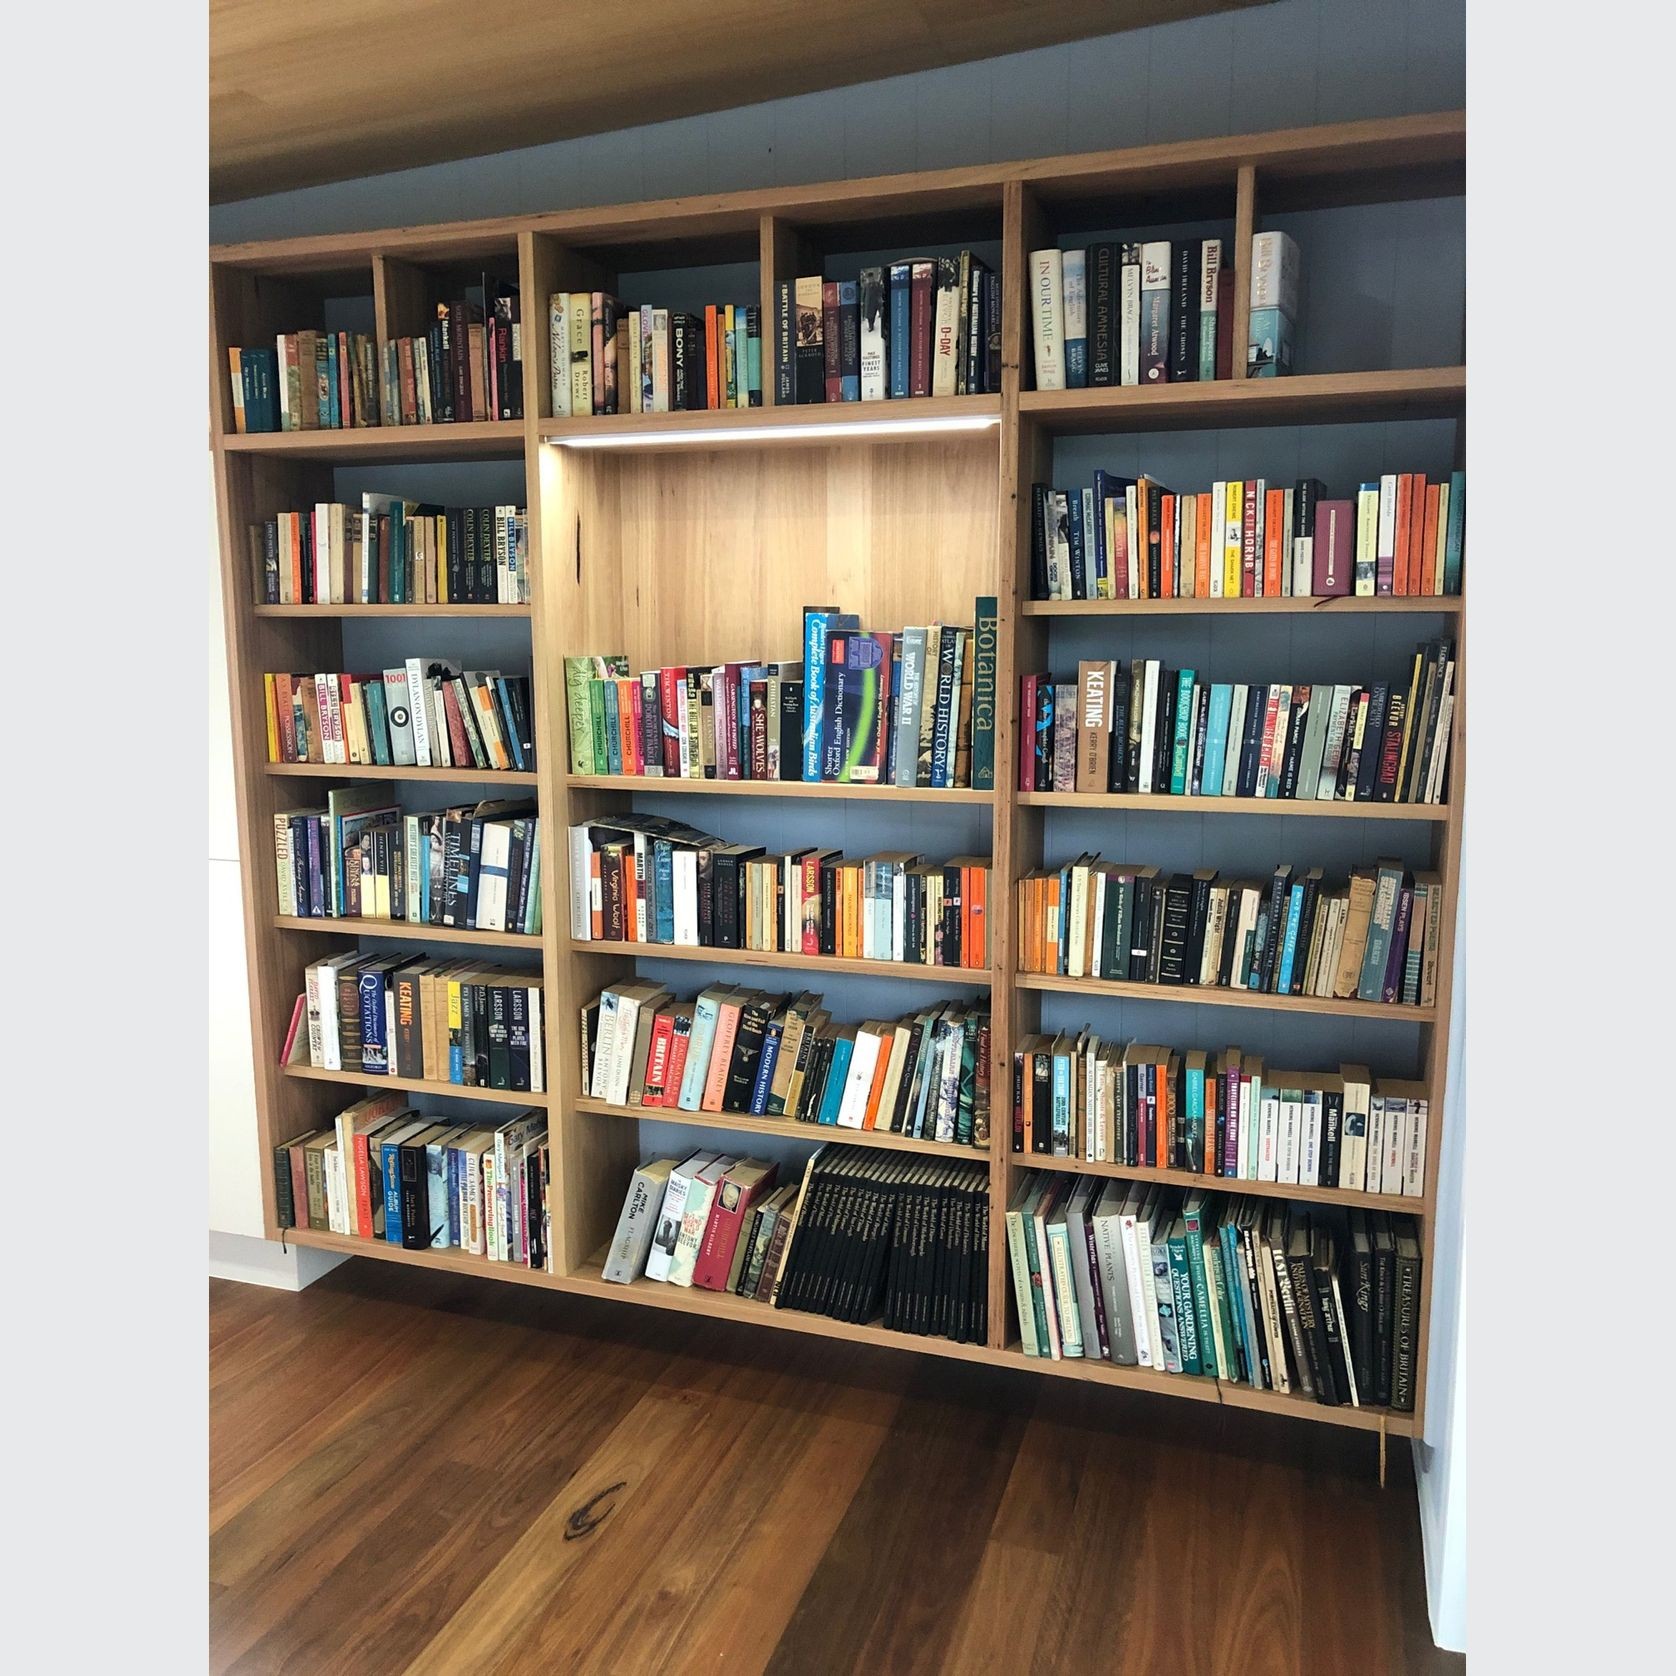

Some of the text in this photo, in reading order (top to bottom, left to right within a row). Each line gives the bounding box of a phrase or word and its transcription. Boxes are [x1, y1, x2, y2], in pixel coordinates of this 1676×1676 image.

[1204, 245, 1218, 304] Bill Bryson
[1039, 260, 1053, 341] IN OUR TIME
[1097, 248, 1110, 361] CULTURAL AMNESIA
[1179, 250, 1190, 361] DAVID IRELAND THE CHOSEN
[441, 320, 450, 350] Mankell
[498, 327, 509, 363] Rankin
[576, 308, 584, 345] Grace
[782, 320, 789, 330] OF
[939, 327, 952, 356] D-DAY
[1149, 295, 1161, 356] Margaret Atwood
[1207, 316, 1217, 362] Shakespeare
[675, 327, 684, 367] BONY
[1070, 347, 1078, 373] BRAGG
[466, 509, 474, 533] COLIN
[482, 509, 490, 533] COLIN
[496, 516, 506, 566] BILL BRYSON
[467, 533, 475, 562] DEXTER
[483, 533, 491, 562] DEXTER
[507, 517, 516, 571] BILL BRYSON
[1244, 530, 1255, 575] HORNBY
[926, 646, 933, 656] OF
[931, 630, 939, 657] HISTORY
[385, 673, 406, 684] 1001
[901, 651, 916, 725] WORLD WAR II
[976, 615, 999, 731] Botanica
[318, 683, 330, 740] BILL BRYSON
[411, 673, 426, 745] DYLAN ON DYLAN
[569, 666, 588, 734] dig deeper
[807, 619, 821, 777] Complete Book of Australian Birds
[934, 647, 954, 771] WORLD HISTORY
[1176, 677, 1192, 740] THE BOOKSHOP BOOK
[1334, 696, 1349, 742] ELIZABETH
[284, 715, 293, 754] POSSESSION
[595, 715, 603, 756] CHURCHILL
[610, 715, 618, 756] CHURCHILL
[624, 715, 633, 756] CHURCHILL
[644, 703, 655, 765] DOROTHY PARKER
[831, 671, 846, 776] Oxford English Dictionary
[1085, 671, 1104, 775] KEATING KERRY O'BRIEN
[1292, 726, 1300, 745] PAMUK
[1379, 694, 1402, 784] BEEVOR STALINGRAD
[824, 746, 834, 775] Shorter
[1287, 756, 1295, 773] NAME
[275, 817, 288, 860] PUZZLED
[447, 832, 461, 906] TIMELINES
[636, 852, 644, 880] MARTIN
[805, 861, 815, 893] LARSSON
[609, 869, 621, 929] Virginia Woolf
[1397, 892, 1409, 932] IBSEN PLAYS
[1214, 915, 1222, 934] Wright
[359, 975, 378, 1044] QUOTATIONS
[399, 982, 412, 1025] KEATING
[450, 993, 460, 1015] Jazz
[493, 990, 503, 1021] LARSSON
[512, 990, 523, 1021] LARSSON
[602, 1014, 615, 1056] BERLIN
[715, 1011, 735, 1095] GEOFFREY BLAINEY
[601, 1056, 609, 1090] ANTONY
[651, 1037, 667, 1084] BRITAIN
[671, 1037, 687, 1096] PEACEMAKERS
[753, 1045, 775, 1114] MODERN HISTORY
[1327, 1108, 1338, 1142] Mankell
[357, 1137, 367, 1196] NIGELLA LAWSON
[628, 1181, 645, 1220] CARLTON
[638, 1192, 649, 1214] MIKE
[705, 1214, 720, 1257] MARTIN GILBERT
[1087, 1234, 1097, 1264] Wisterias
[1100, 1220, 1114, 1281] NATIVE PLANTS
[1171, 1268, 1189, 1361] QUESTIONS ANSWERED
[1180, 1272, 1197, 1360] YOUR GARDENING
[1196, 1283, 1209, 1329] CAMELLIA
[1398, 1274, 1413, 1396] TREASURES OF BRITAIN
